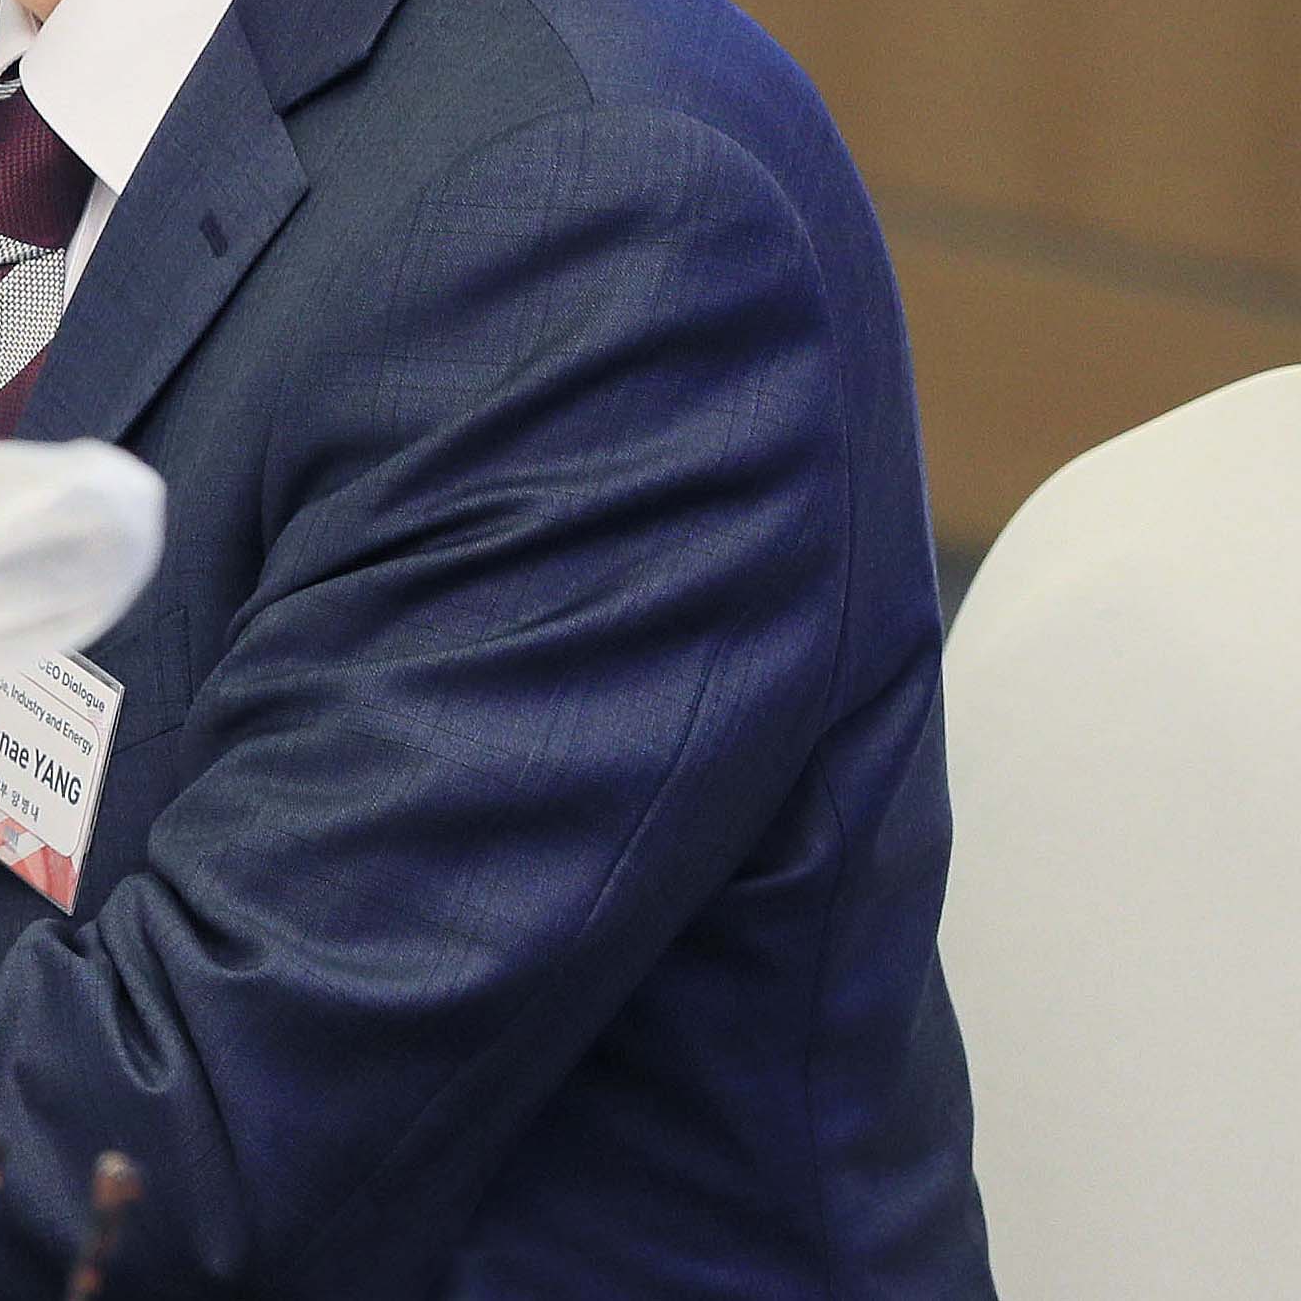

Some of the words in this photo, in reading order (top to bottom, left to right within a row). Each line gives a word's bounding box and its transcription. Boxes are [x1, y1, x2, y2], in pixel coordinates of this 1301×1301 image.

[11, 685, 45, 720] Industry
[46, 713, 63, 731] and
[63, 723, 93, 755] Energy
[62, 673, 105, 712] Dialogue
[34, 748, 82, 805] YANG
